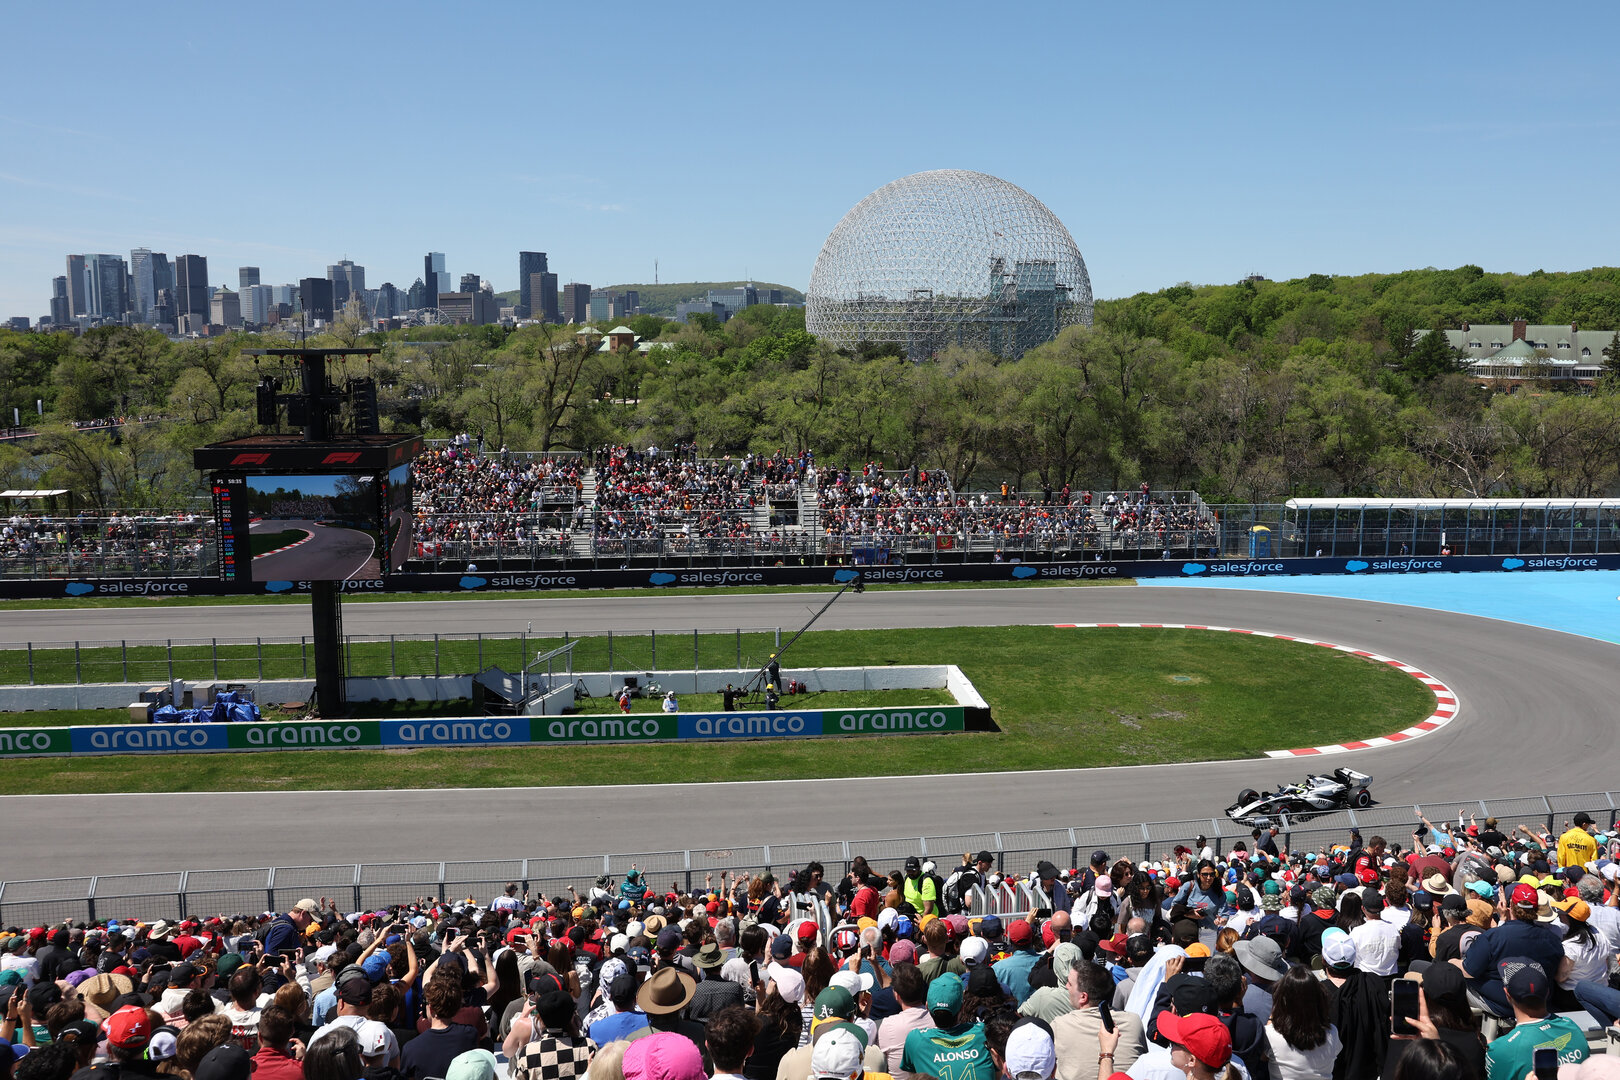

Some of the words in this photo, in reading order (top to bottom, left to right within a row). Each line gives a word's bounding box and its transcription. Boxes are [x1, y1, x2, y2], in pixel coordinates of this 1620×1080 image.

[1210, 562, 1284, 575] salesforce
[1372, 557, 1442, 571] salesforce
[1528, 556, 1598, 569] salesforce
[680, 571, 763, 585] salesforce
[864, 567, 944, 582] salesforce
[1041, 565, 1117, 578] salesforce
[99, 580, 188, 596] salesforce
[491, 573, 576, 588] salesforce
[548, 718, 660, 738] aramco
[695, 714, 805, 735] aramco
[838, 710, 947, 731] aramco
[90, 729, 209, 748] aramco
[246, 724, 361, 744] aramco
[398, 721, 512, 741] aramco
[933, 1048, 979, 1063] ALONSO
[938, 1062, 977, 1080] 14
